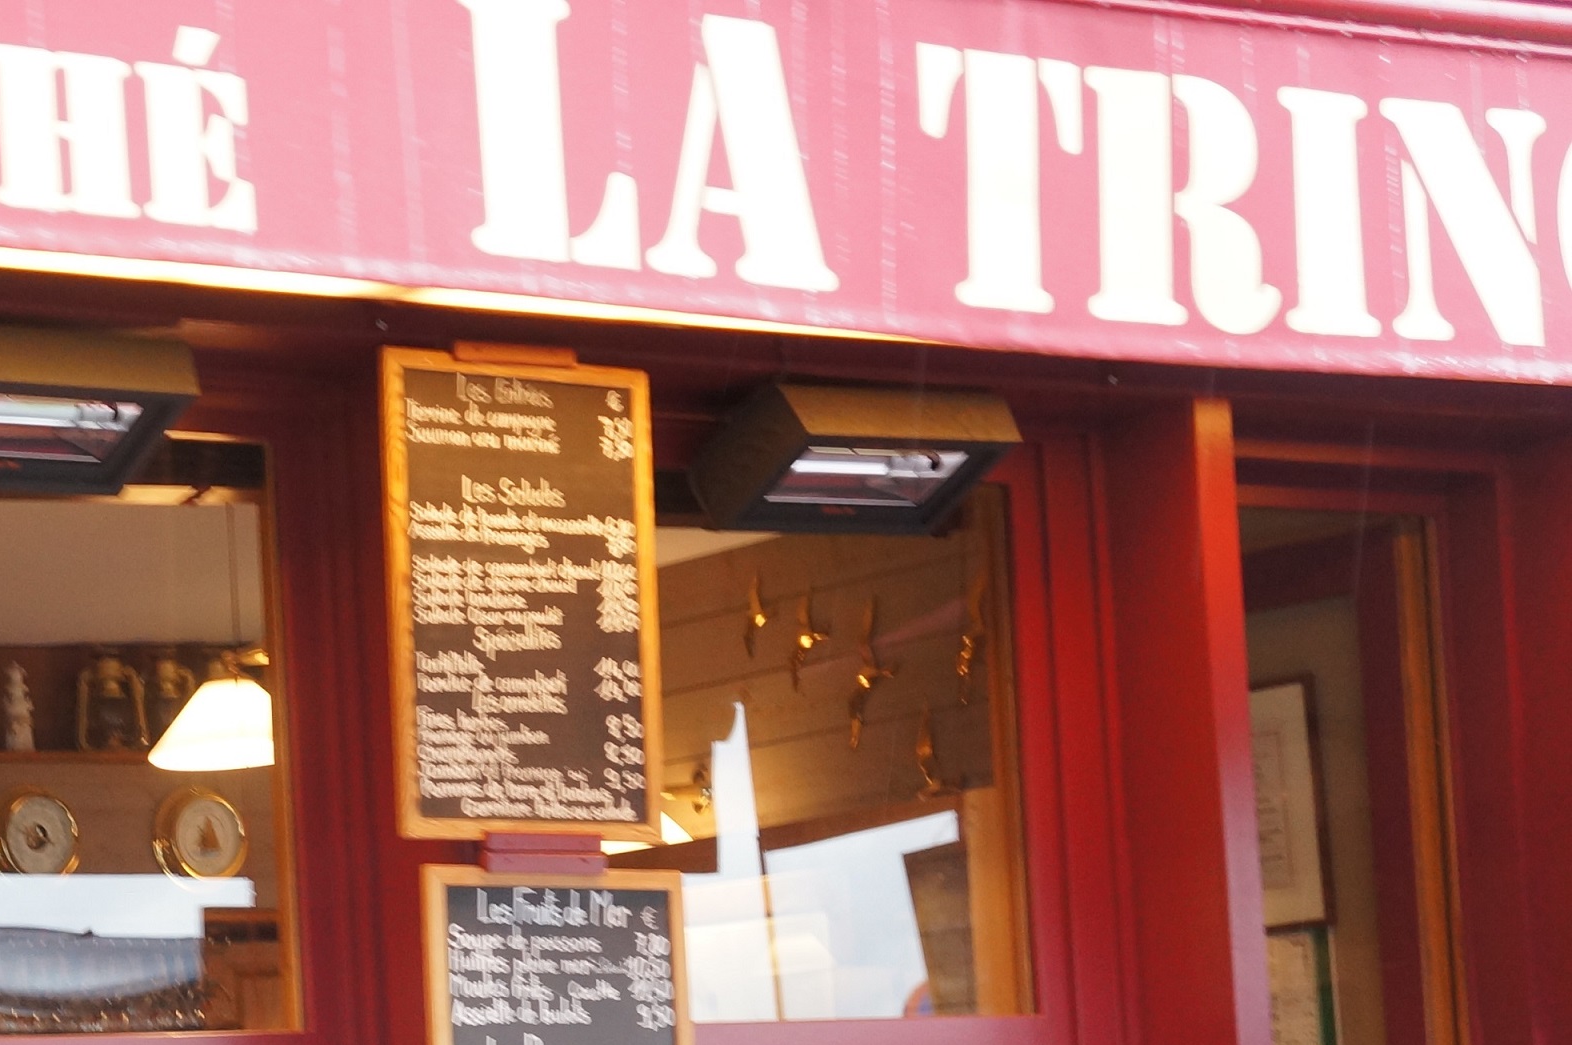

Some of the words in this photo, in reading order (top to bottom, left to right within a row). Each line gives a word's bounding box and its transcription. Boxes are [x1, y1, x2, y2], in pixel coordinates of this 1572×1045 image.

[450, 0, 839, 291] LA
[916, 43, 1572, 347] TRIN
[460, 473, 500, 505] Les
[497, 475, 568, 509] Salades
[476, 887, 513, 925] Les
[589, 890, 632, 929] Mer
[448, 922, 506, 956] Soupe
[505, 923, 530, 951] de
[529, 933, 603, 959] poissons
[448, 972, 510, 1000] Moules
[450, 998, 518, 1027] Assiette
[515, 999, 541, 1026] de
[538, 997, 593, 1026] bulots
